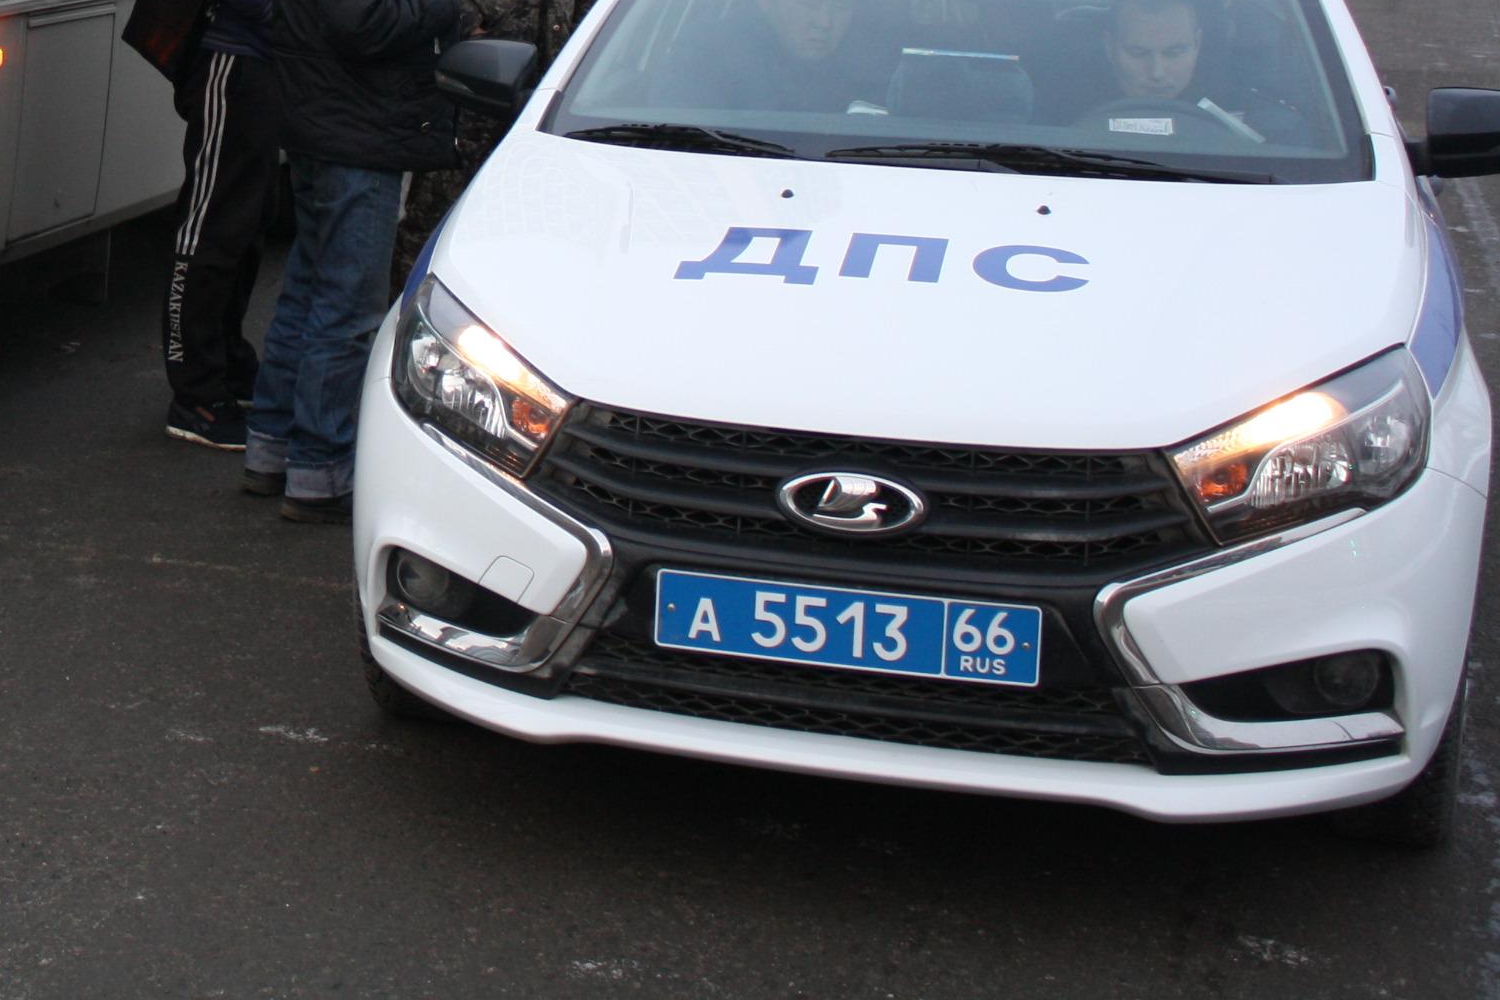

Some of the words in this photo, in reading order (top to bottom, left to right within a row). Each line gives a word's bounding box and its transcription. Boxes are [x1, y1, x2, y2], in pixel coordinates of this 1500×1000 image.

[673, 226, 1090, 292] ДПС
[751, 590, 908, 661] 5513
[952, 608, 1015, 656] 66
[959, 655, 1006, 675] RUS
